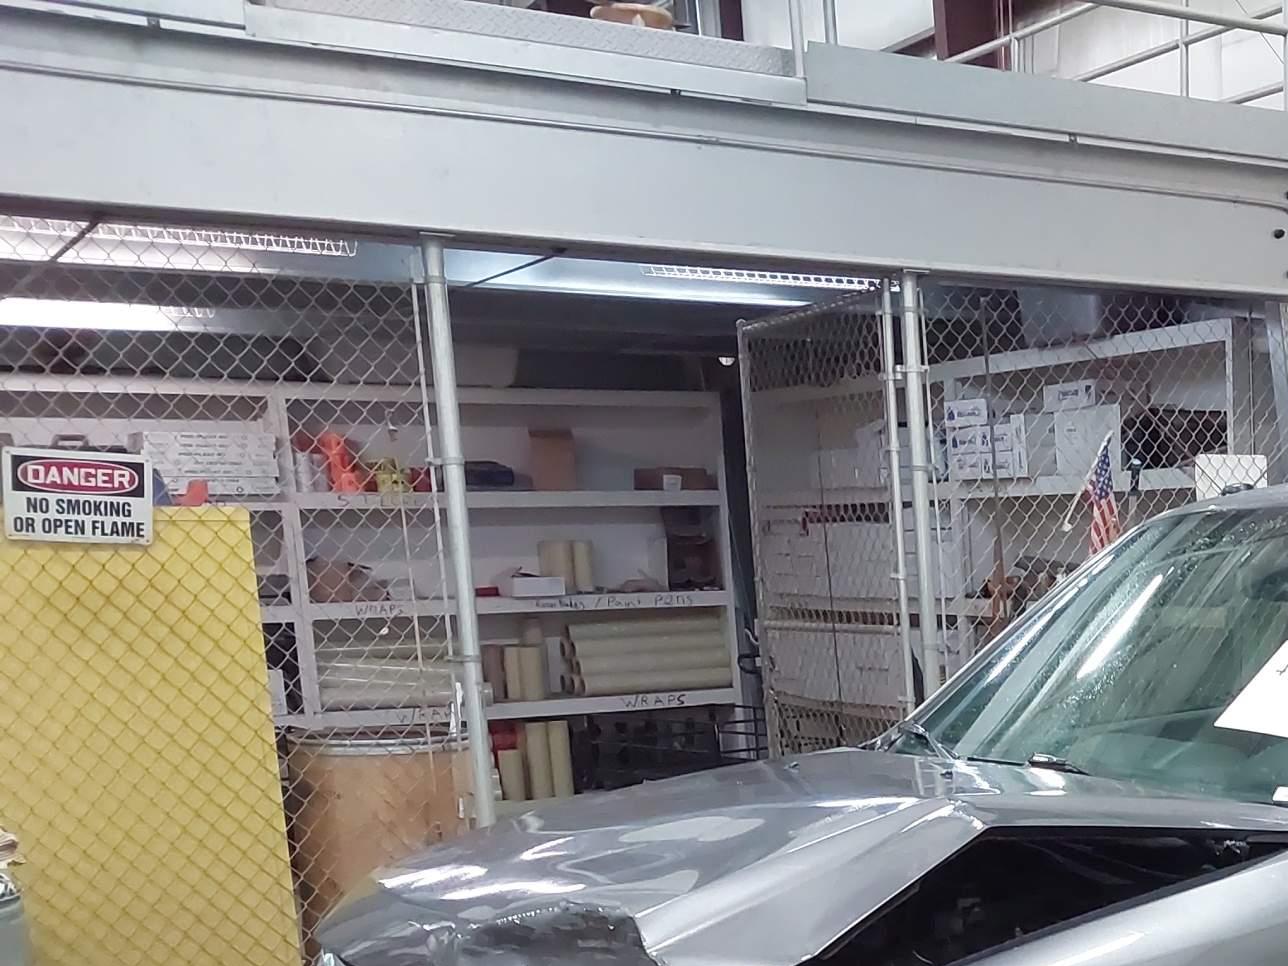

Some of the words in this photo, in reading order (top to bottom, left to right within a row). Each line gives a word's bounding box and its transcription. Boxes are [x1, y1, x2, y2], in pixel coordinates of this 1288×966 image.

[26, 464, 131, 489] DANGER
[26, 497, 49, 514] NO
[55, 498, 132, 517] SMOKING
[13, 516, 36, 533] OR
[42, 518, 86, 535] OPEN
[91, 520, 145, 538] FLAME
[619, 693, 687, 709] WRAPS
